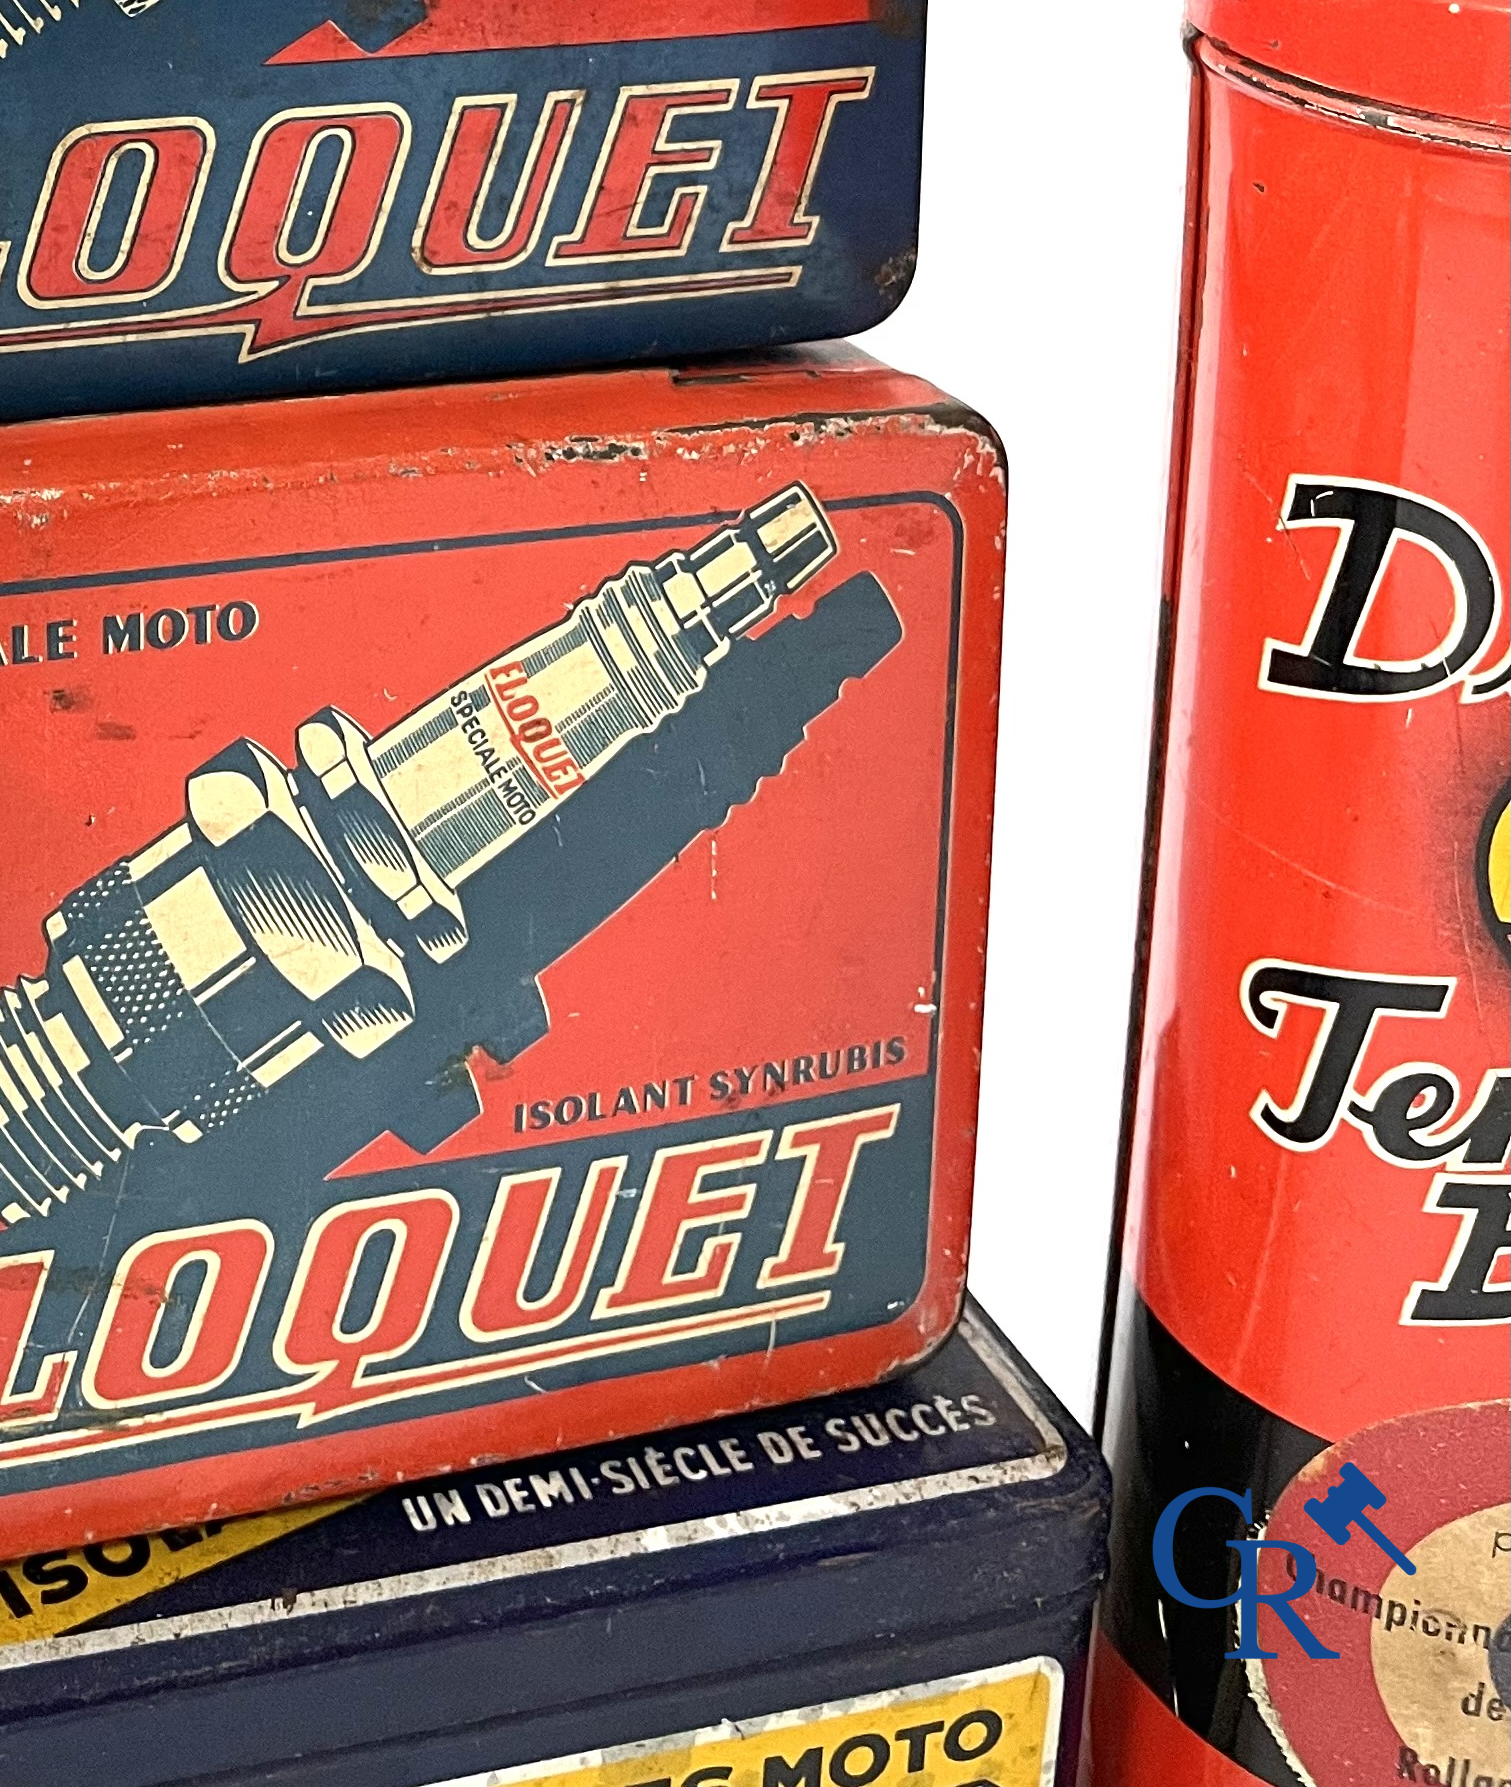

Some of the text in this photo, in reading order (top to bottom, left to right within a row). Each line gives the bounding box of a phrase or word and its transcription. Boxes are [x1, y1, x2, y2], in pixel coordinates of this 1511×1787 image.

[102, 600, 259, 655] MOTO
[451, 690, 537, 825] SPECIALE MOTO
[487, 661, 587, 797] FLOQUET
[513, 1036, 906, 1133] ISOLANT SYNRUBIS
[401, 1489, 472, 1534] UN
[758, 1428, 822, 1465] DE
[824, 1393, 997, 1454] SUCCÈS
[762, 1709, 1003, 1787] MOTO
